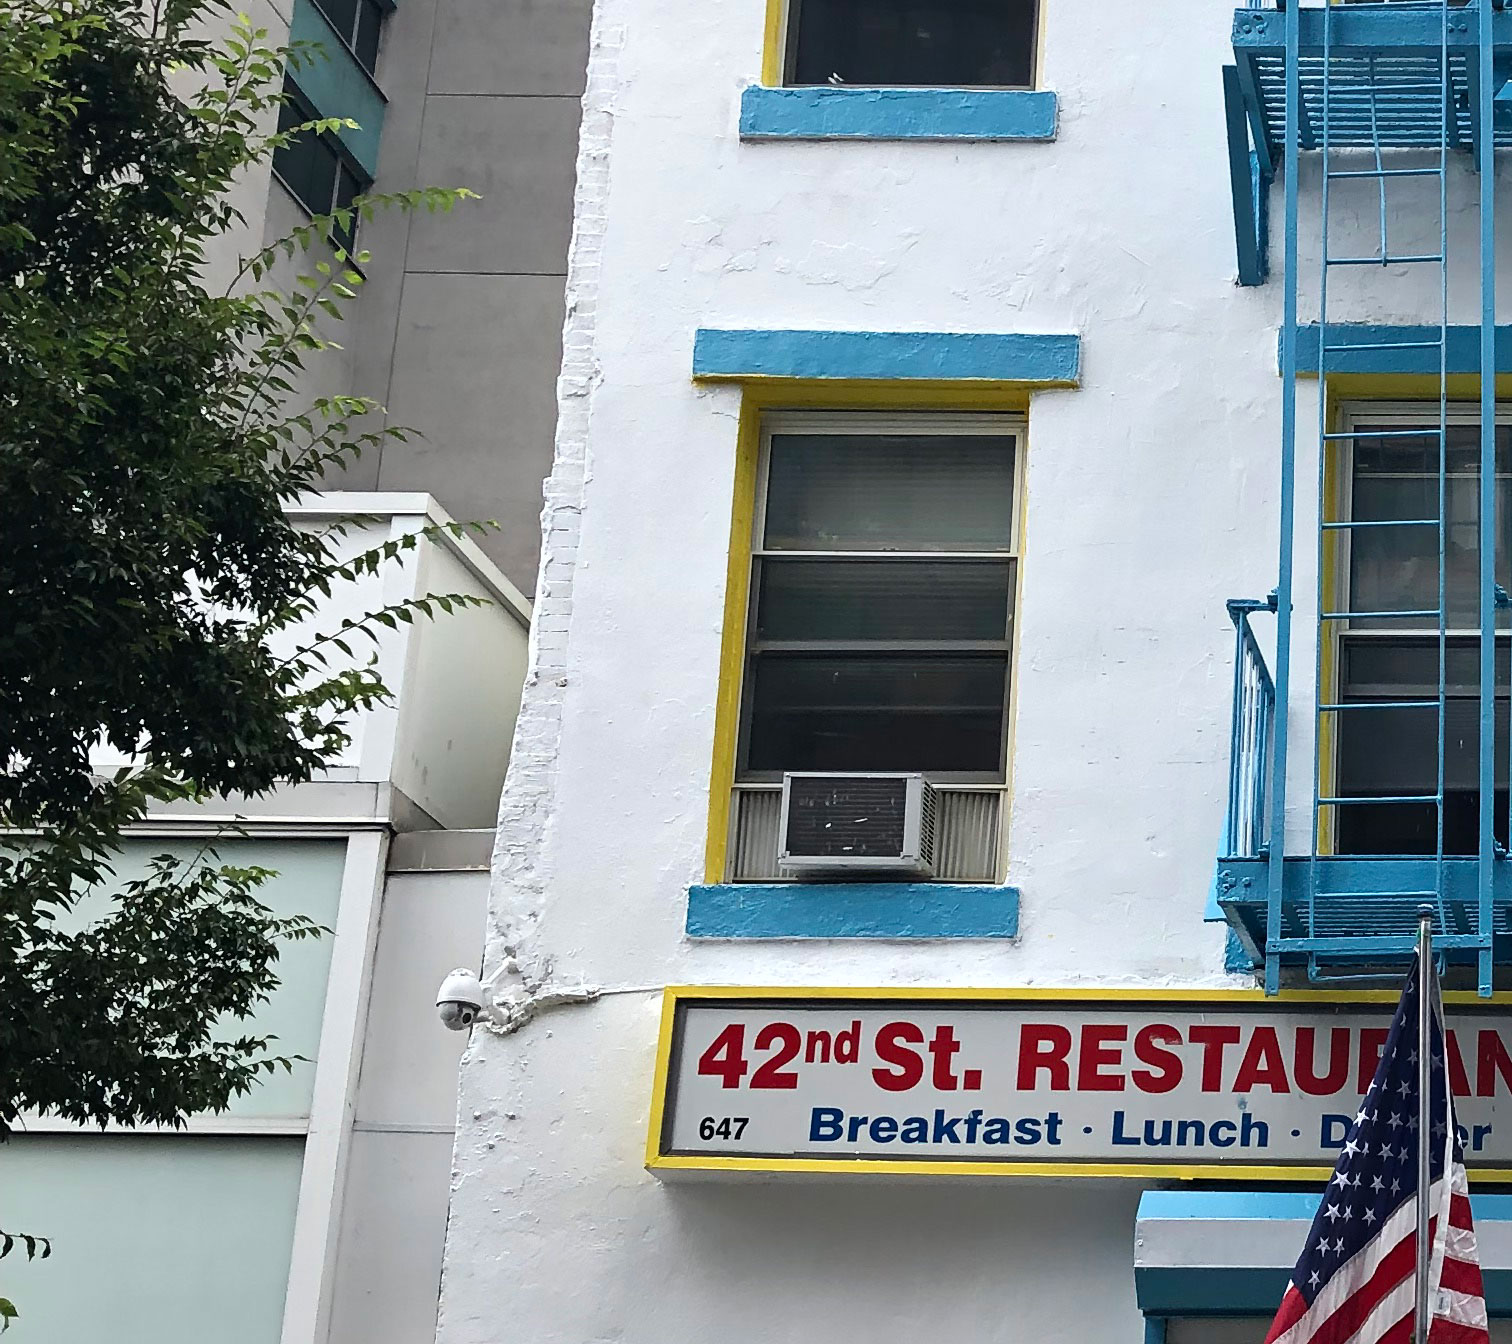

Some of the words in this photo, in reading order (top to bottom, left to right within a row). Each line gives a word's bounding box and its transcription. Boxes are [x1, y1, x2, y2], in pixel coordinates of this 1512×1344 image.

[697, 1019, 861, 1090] 42nd
[872, 1021, 983, 1092] St.
[698, 1116, 750, 1141] 647
[808, 1106, 1062, 1147] Breakfast
[1111, 1110, 1269, 1149] Lunch
